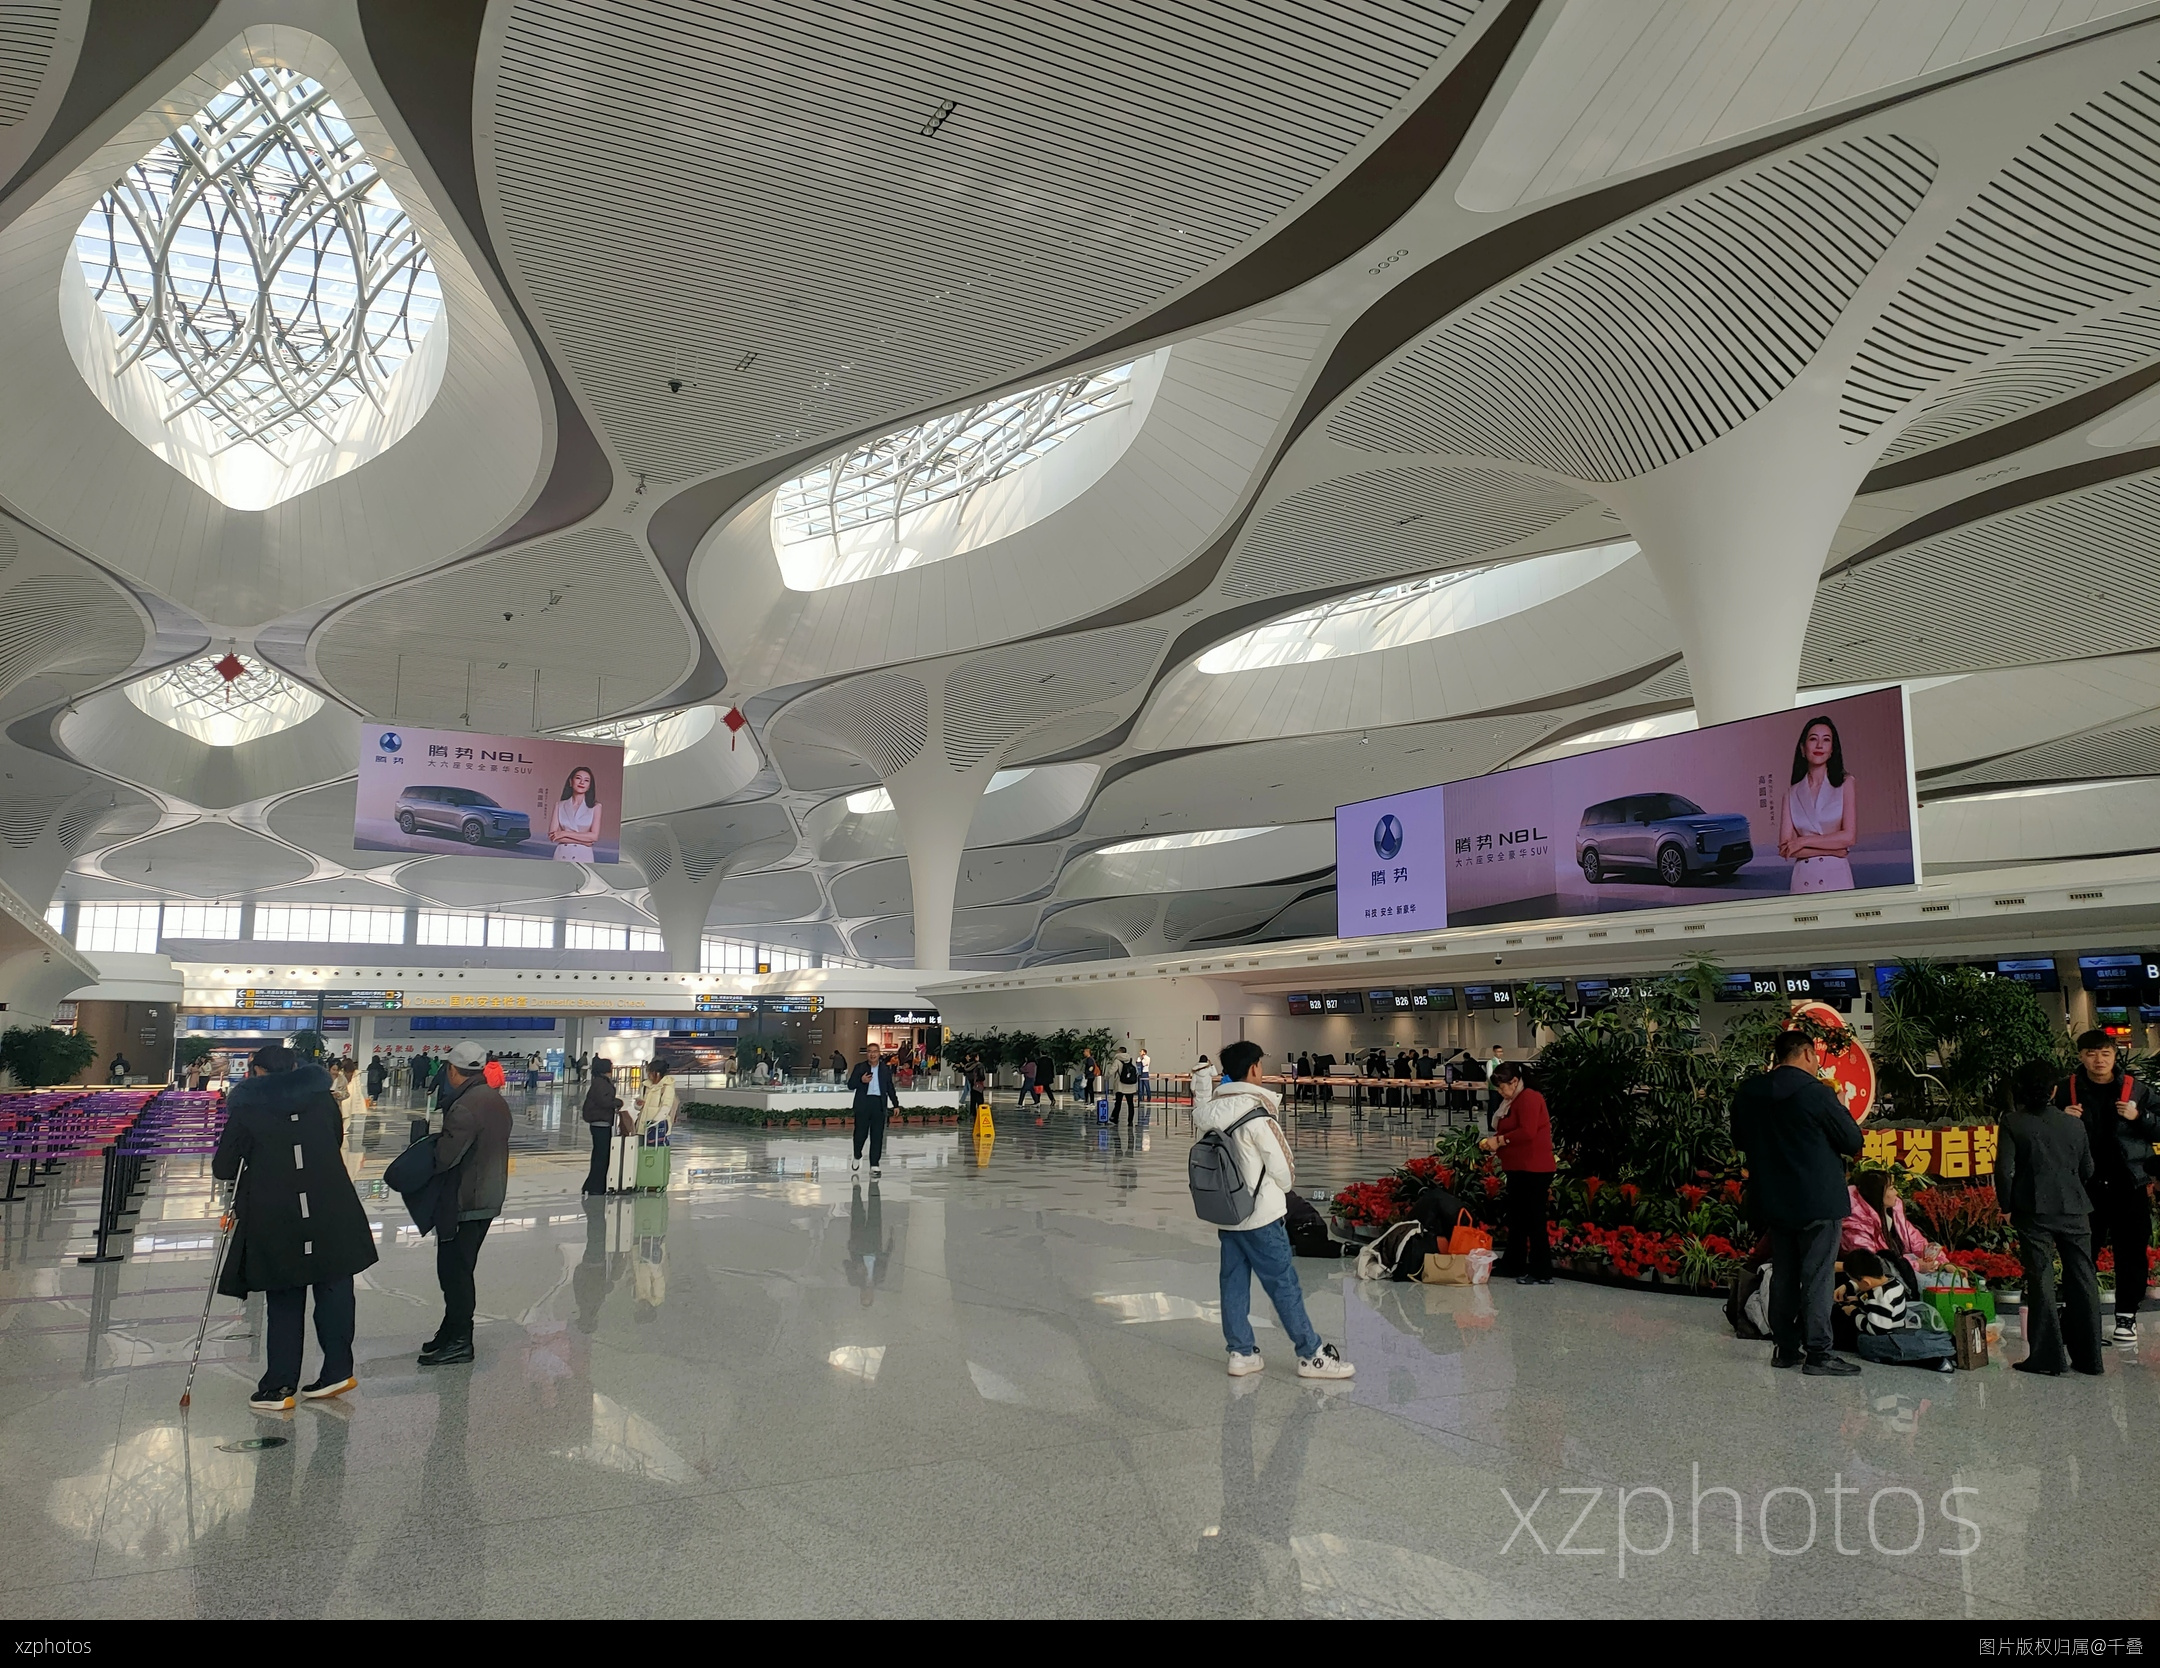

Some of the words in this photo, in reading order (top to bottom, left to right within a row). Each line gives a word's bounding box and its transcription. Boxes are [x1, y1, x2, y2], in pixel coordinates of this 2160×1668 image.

[428, 744, 474, 760] 腾势
[480, 750, 534, 764] N8L
[1454, 833, 1493, 855] 腾势
[1499, 827, 1548, 846] N8L
[1371, 866, 1408, 887] 腾势
[1364, 908, 1378, 919] 科技
[1380, 906, 1393, 918] 安全
[1754, 980, 1777, 993] B20
[1786, 979, 1811, 992] B19
[414, 996, 447, 1006] Check
[449, 995, 529, 1008] 国内安全检查
[577, 998, 615, 1008] Security
[617, 998, 647, 1008] Check
[1394, 996, 1410, 1006] B26
[1413, 995, 1428, 1006] B25
[1493, 991, 1510, 1003] B24
[1309, 999, 1322, 1009] B28
[1326, 999, 1338, 1009] B27
